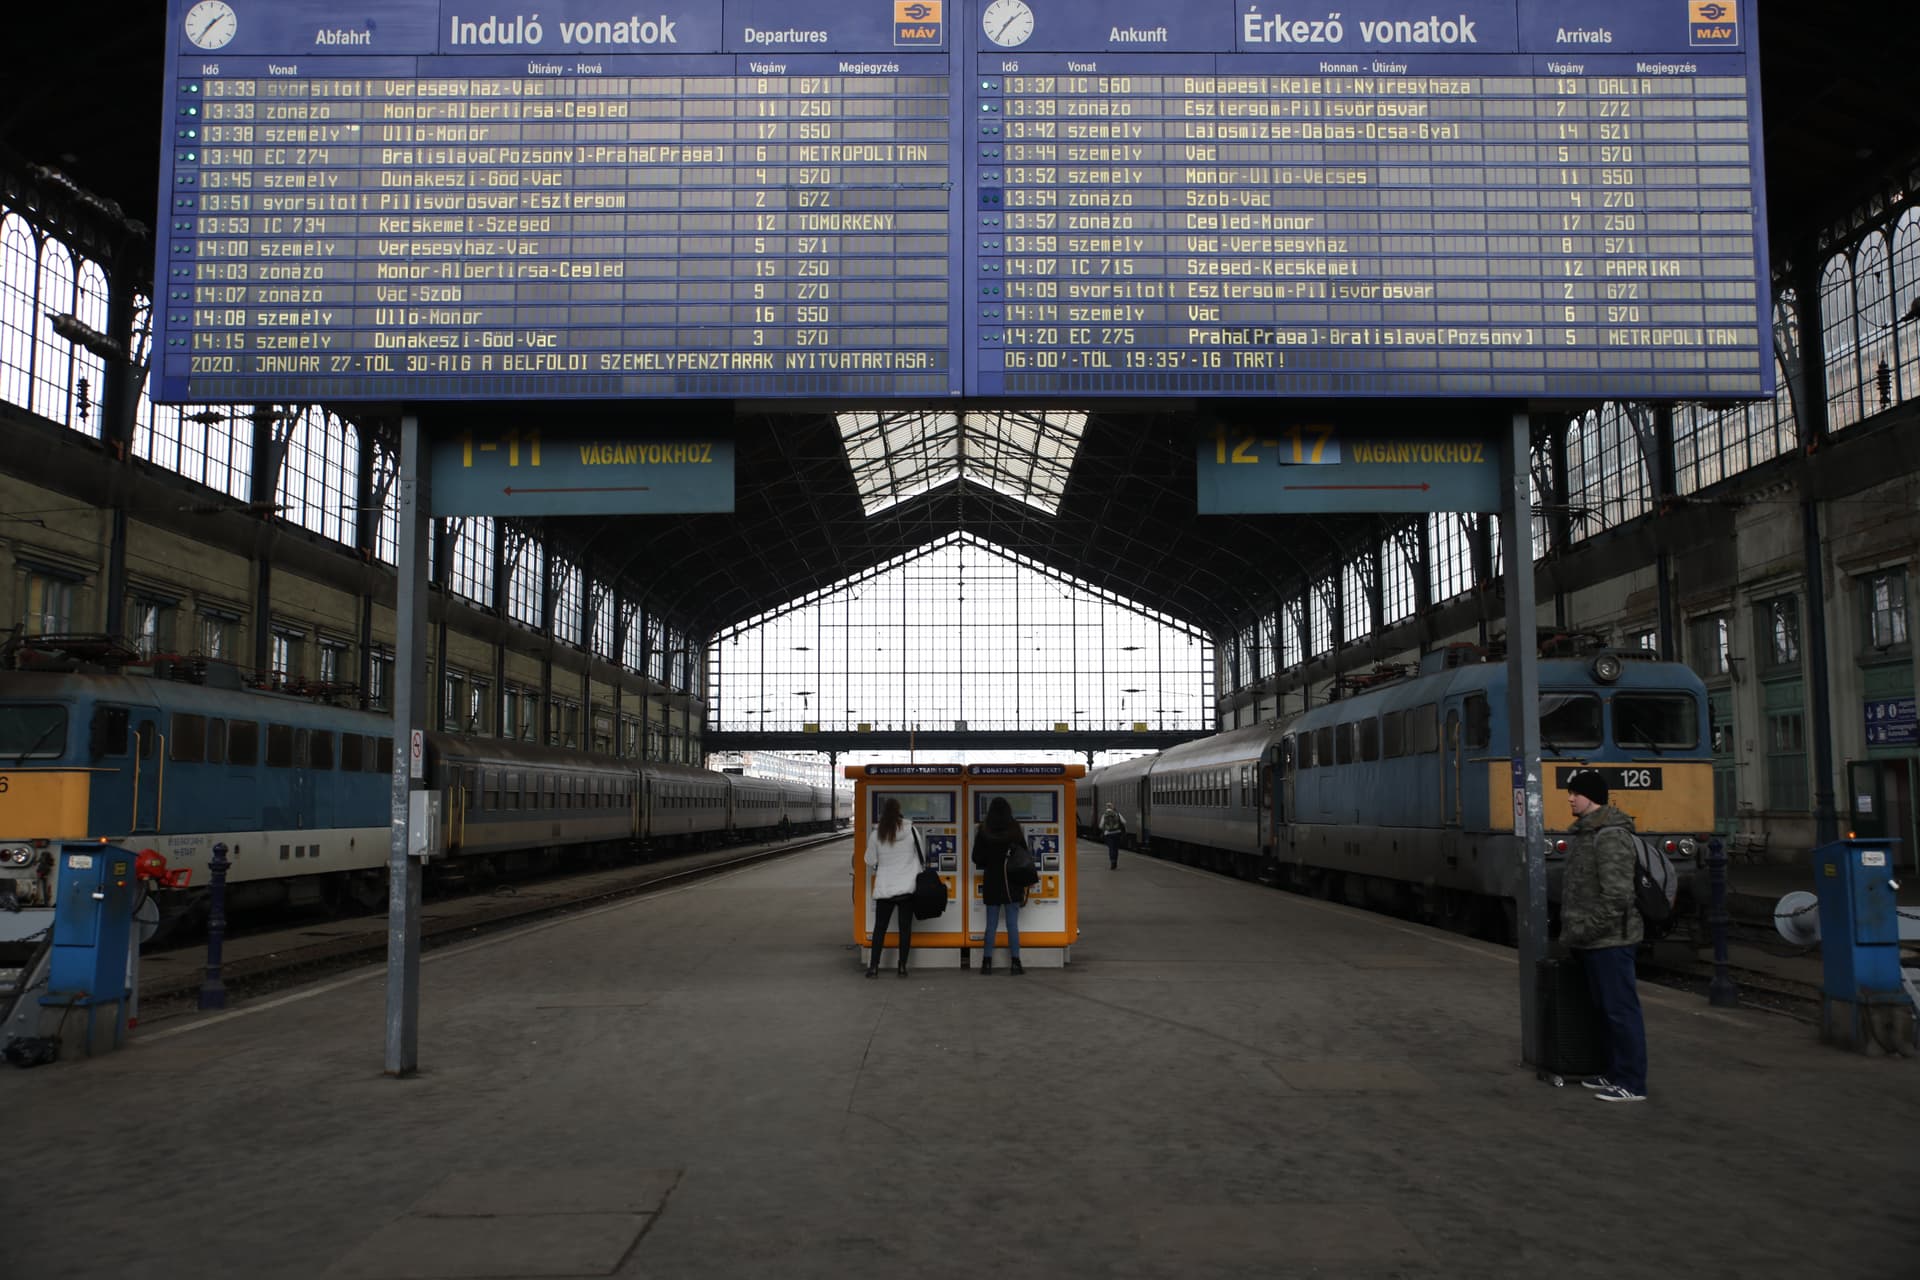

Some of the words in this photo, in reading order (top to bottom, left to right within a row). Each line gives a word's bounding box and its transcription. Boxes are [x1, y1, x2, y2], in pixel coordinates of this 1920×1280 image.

[451, 13, 543, 45] Induló
[560, 15, 677, 44] vonatok
[902, 25, 936, 40] MÁV
[1243, 6, 1343, 44] Érkező
[1359, 14, 1477, 44] vonatok
[1697, 25, 1732, 39] MÁV
[316, 30, 371, 45] Abfahrt
[744, 27, 828, 45] Departures
[1109, 27, 1168, 43] Ankunft
[1556, 28, 1612, 44] Arrivals
[202, 63, 219, 75] Idő
[269, 64, 297, 75] Vonat
[527, 61, 564, 76] Útirány
[576, 62, 602, 75] Hová
[750, 61, 786, 75] Vágány
[839, 61, 899, 75] Megjegyzés
[1002, 61, 1018, 72] Idő
[1067, 62, 1097, 72] Vonat
[1319, 62, 1358, 73] Honnan
[1372, 60, 1407, 75] Útirány
[1548, 62, 1584, 75] Vágány
[1636, 62, 1697, 74] Megjegyzés
[205, 80, 256, 96] 13:33
[758, 78, 768, 94] 8
[1004, 77, 1055, 93] 13:37
[1069, 77, 1088, 93] IC
[1099, 78, 1130, 93] 560
[1557, 79, 1577, 95] 13
[1599, 79, 1651, 95] DALIA
[204, 103, 255, 119] 13:33
[758, 101, 776, 117] 11
[1004, 100, 1056, 116] 13:39
[1556, 101, 1566, 117] 7
[1600, 101, 1630, 117] Z72
[203, 125, 254, 142] 13:38
[758, 124, 777, 140] 17
[799, 124, 831, 140] S50
[1004, 122, 1056, 138] 13:42
[1559, 124, 1578, 140] 14
[1600, 124, 1630, 140] S21
[201, 148, 253, 164] 13:40
[265, 148, 285, 164] EC
[296, 148, 329, 164] 274
[756, 146, 767, 162] 6
[799, 146, 928, 162] METROPOLITAN
[1004, 145, 1056, 161] 13:44
[1558, 146, 1568, 162] 5
[1601, 147, 1632, 163] S70
[201, 172, 252, 188] 13:45
[756, 169, 767, 185] 4
[799, 168, 831, 184] S70
[1005, 167, 1056, 183] 13:52
[1561, 169, 1578, 185] 11
[1602, 169, 1633, 185] S50
[200, 195, 249, 211] 13:51
[756, 192, 766, 208] 2
[1005, 190, 1057, 206] 13:54
[1570, 191, 1581, 207] 4
[1603, 192, 1634, 207] Z70
[198, 217, 250, 234] 13:53
[263, 217, 282, 233] IC
[293, 217, 326, 233] 734
[756, 215, 776, 231] 12
[1005, 213, 1057, 229] 13:57
[1562, 215, 1581, 231] 17
[1604, 215, 1635, 231] Z50
[197, 240, 249, 256] 14:00
[755, 238, 765, 254] 5
[798, 238, 828, 254] S71
[1005, 236, 1057, 252] 13:59
[1562, 238, 1572, 253] 8
[1604, 238, 1635, 254] S71
[197, 263, 248, 280] 14:03
[756, 261, 775, 277] 15
[798, 260, 830, 277] Z50
[1005, 259, 1057, 275] 14:07
[1071, 259, 1090, 275] IC
[1100, 259, 1133, 275] 715
[1564, 260, 1584, 276] 12
[1606, 261, 1680, 277] PAPRIKA
[196, 287, 247, 303] 14:07
[754, 284, 764, 300] 9
[798, 284, 828, 300] Z70
[1006, 282, 1057, 298] 14:09
[1564, 283, 1574, 299] 2
[1607, 284, 1638, 300] G72
[195, 310, 246, 326] 14:08
[755, 307, 774, 323] 16
[797, 307, 828, 323] S50
[1006, 304, 1058, 320] 14:14
[1565, 306, 1575, 322] 6
[1608, 306, 1639, 322] S70
[194, 333, 245, 349] 14:15
[753, 330, 763, 346] 3
[797, 330, 828, 346] S70
[1007, 328, 1058, 344] 14:20
[1070, 328, 1090, 344] EC
[1102, 328, 1135, 344] 275
[1566, 329, 1576, 345] 5
[1609, 329, 1737, 345] METROPOLITAN
[191, 356, 241, 373] 2020.
[482, 355, 492, 372] A
[1233, 352, 1285, 368] TART!
[1621, 769, 1651, 787] 126
